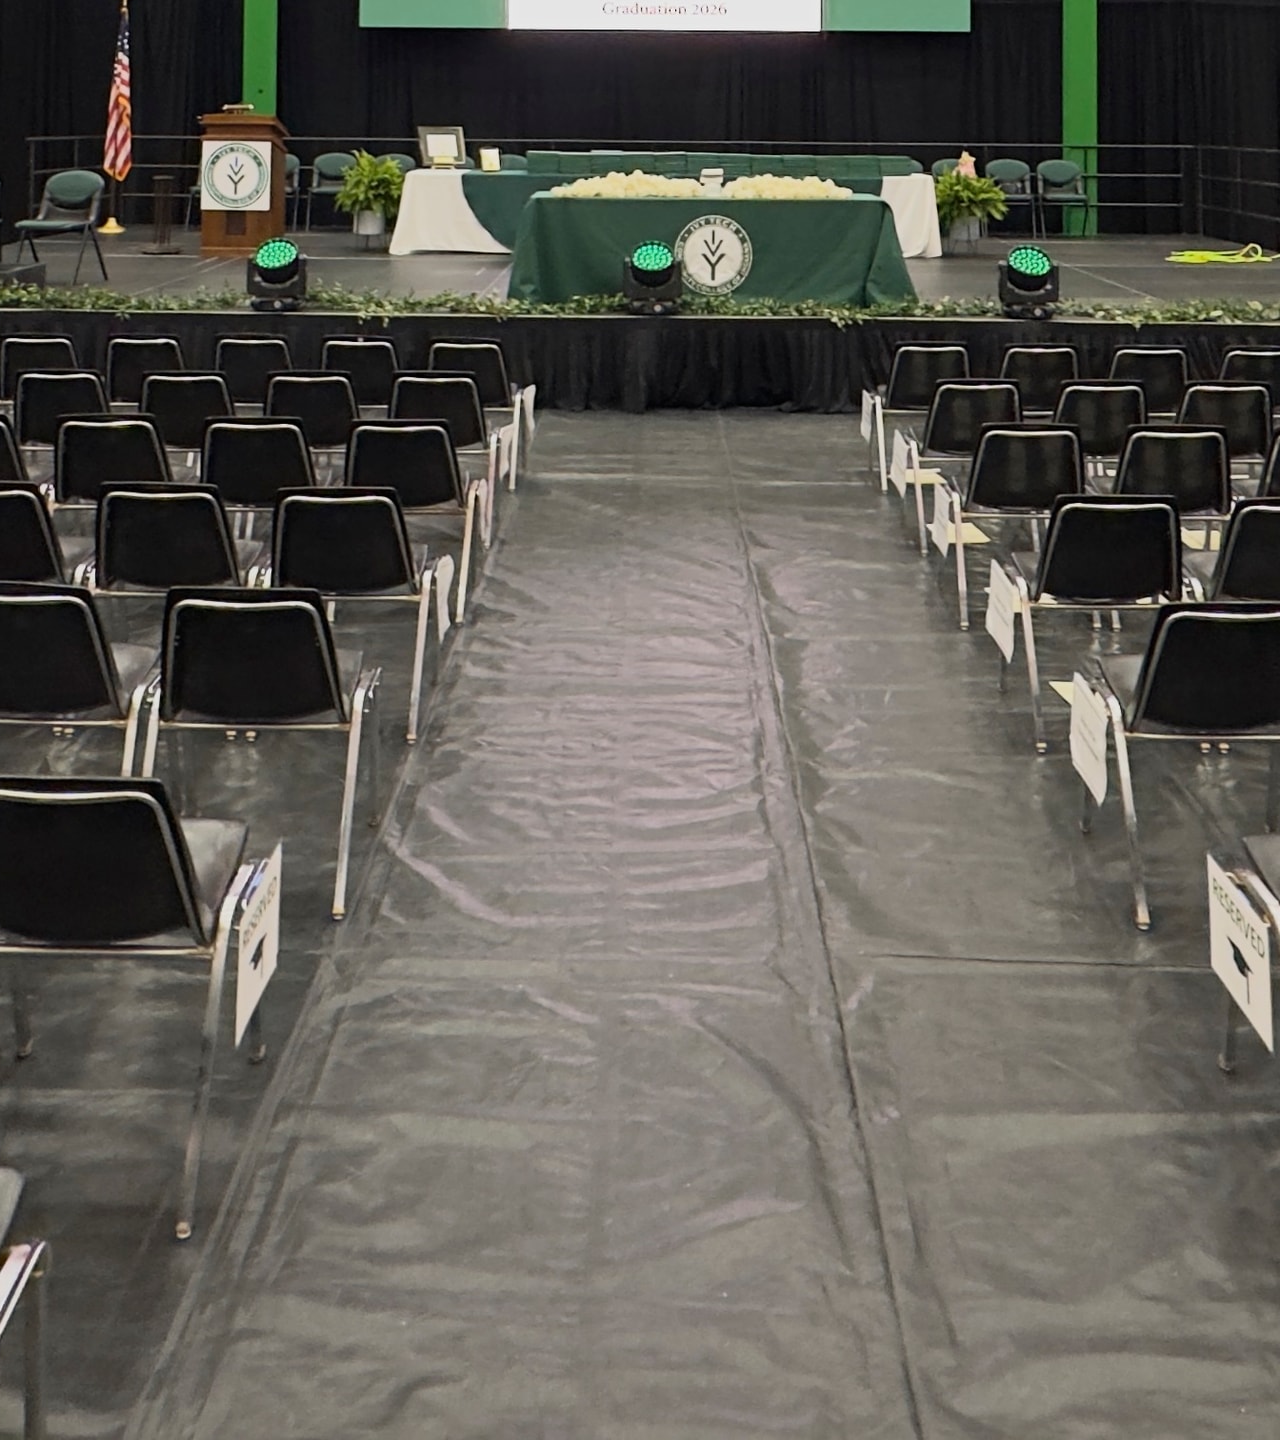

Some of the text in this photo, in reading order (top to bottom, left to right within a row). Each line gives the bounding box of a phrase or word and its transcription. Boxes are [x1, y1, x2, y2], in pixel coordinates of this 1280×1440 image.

[602, 1, 728, 16] Graduation 2026
[690, 218, 738, 232] IVY TECH
[1212, 877, 1267, 959] RESERVED
